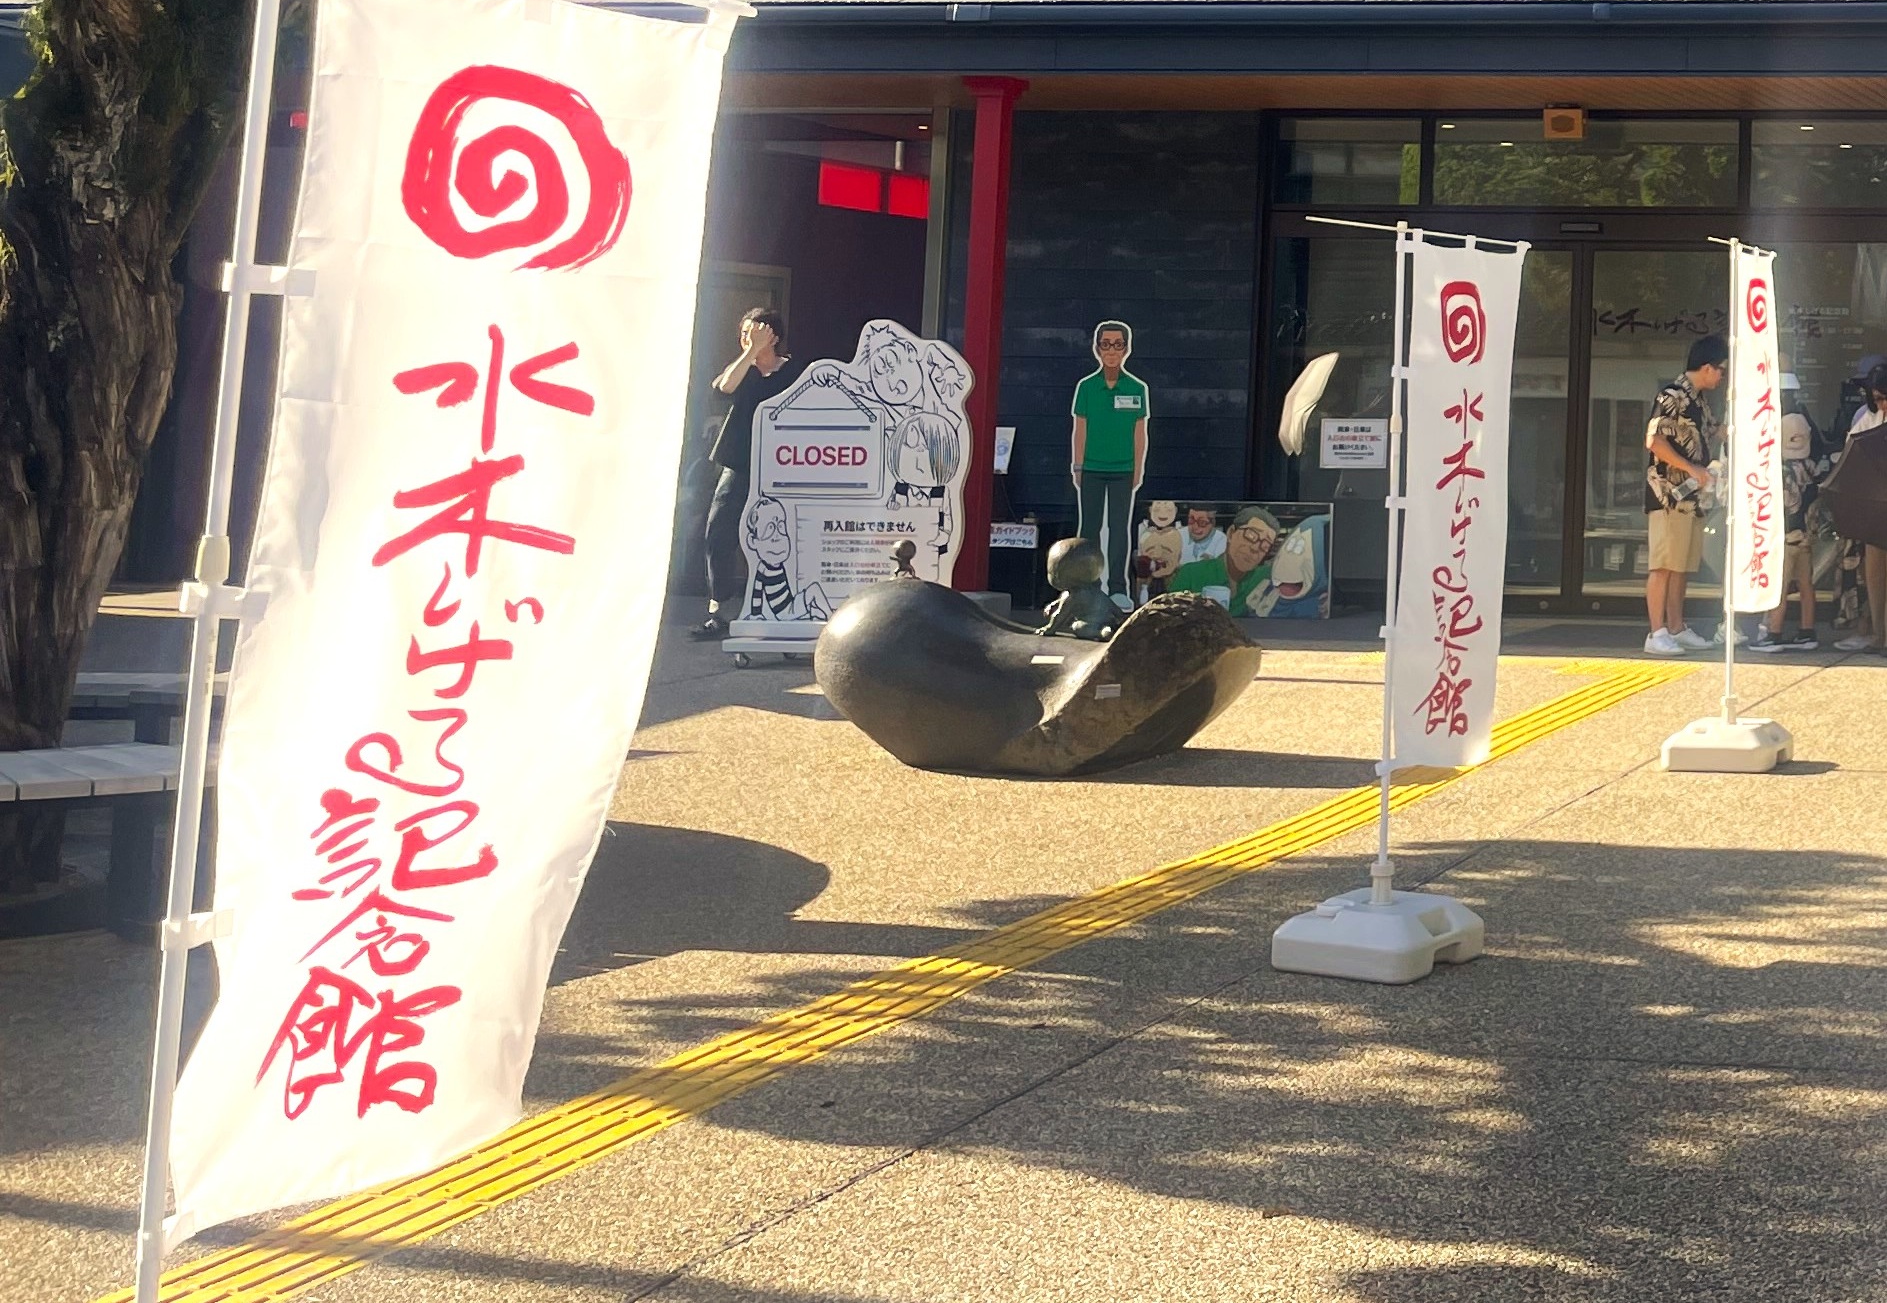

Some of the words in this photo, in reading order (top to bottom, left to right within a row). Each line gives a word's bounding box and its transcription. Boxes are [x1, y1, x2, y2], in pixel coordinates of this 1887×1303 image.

[775, 445, 868, 466] CLOSED
[823, 520, 916, 533] 再入館はできません
[1414, 389, 1485, 738] 水木しげる記念館
[257, 325, 594, 1120] 水木しげる記念館
